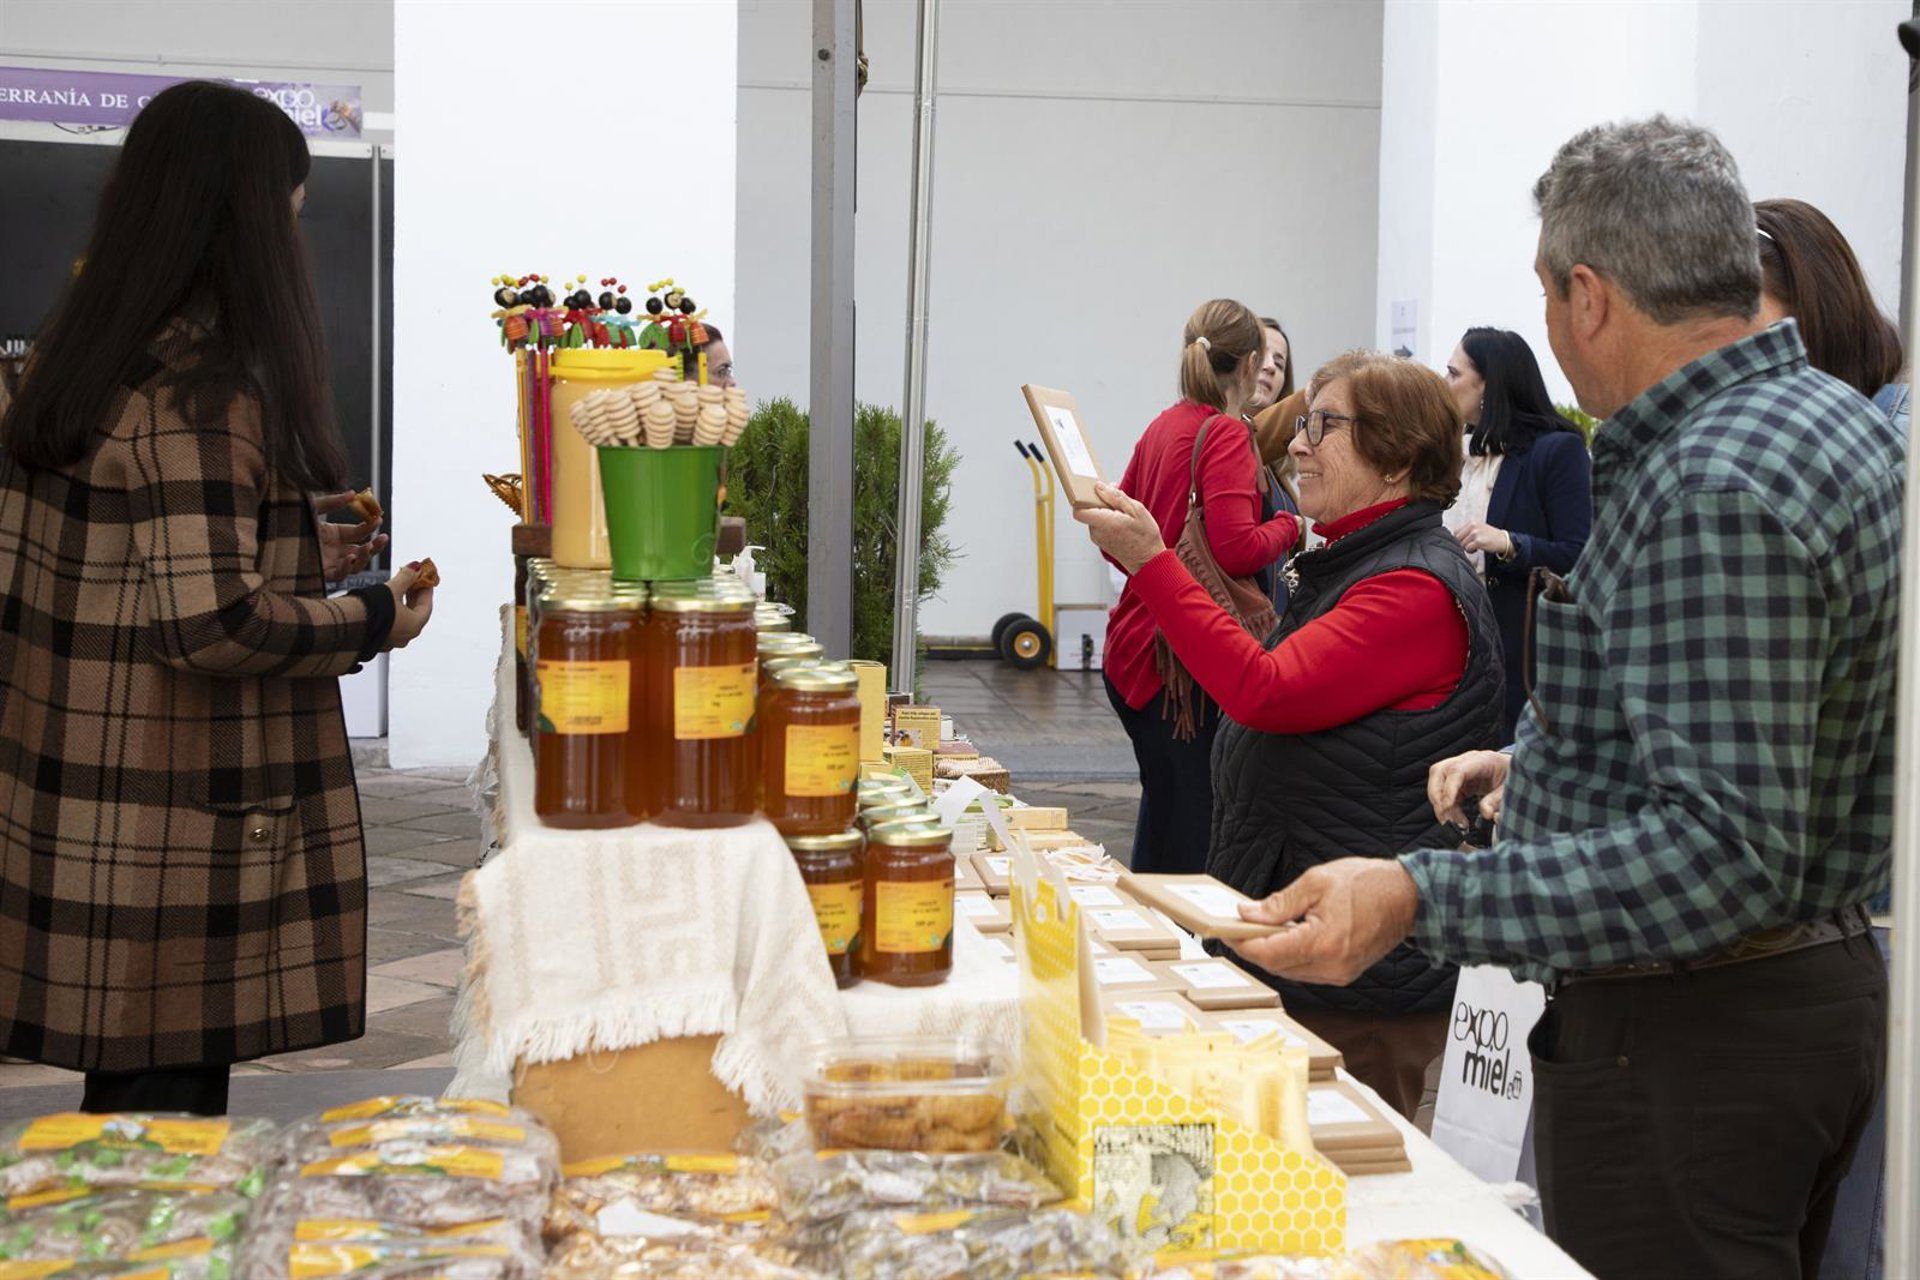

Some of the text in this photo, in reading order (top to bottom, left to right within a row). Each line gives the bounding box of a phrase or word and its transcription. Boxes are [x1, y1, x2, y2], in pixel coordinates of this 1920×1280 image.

[100, 93, 129, 109] DE
[1454, 1001, 1509, 1056] expo
[1462, 1048, 1510, 1098] miel
